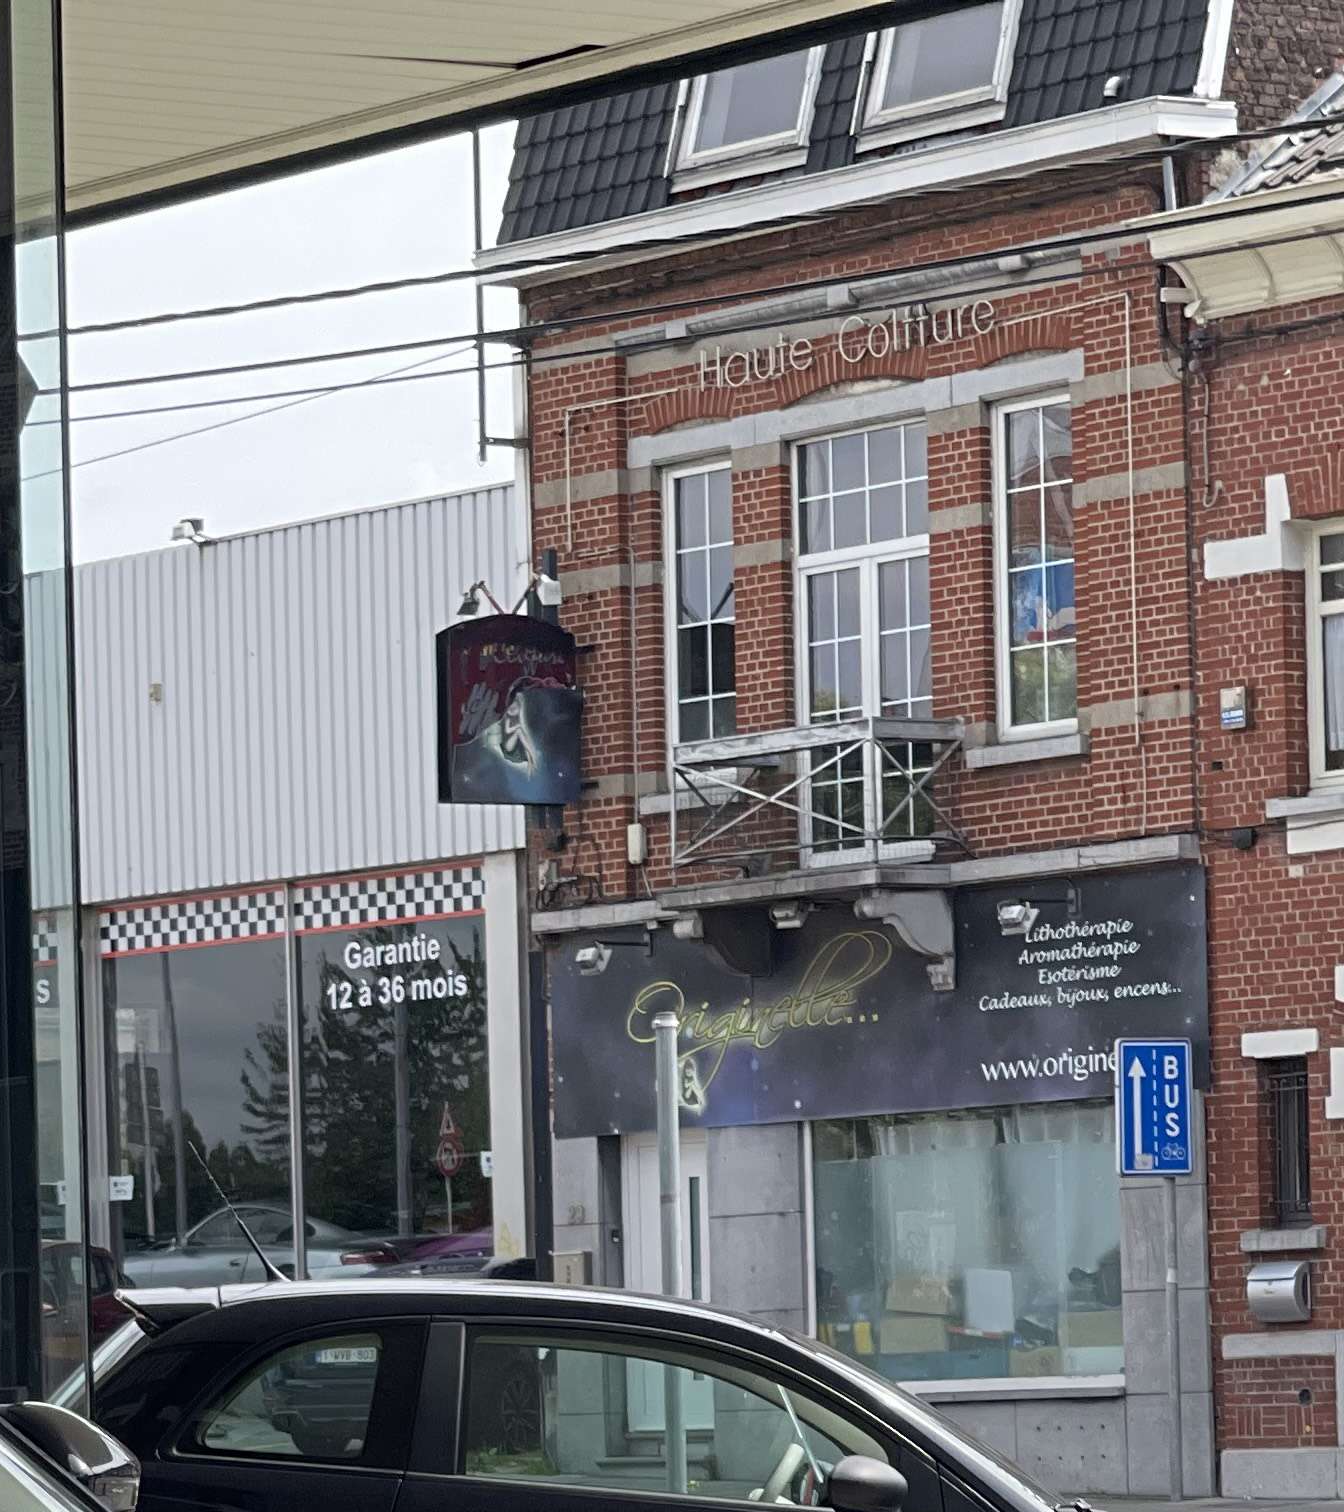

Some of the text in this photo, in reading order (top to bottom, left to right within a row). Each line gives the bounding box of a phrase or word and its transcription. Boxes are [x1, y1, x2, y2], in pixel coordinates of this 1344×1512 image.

[699, 333, 814, 392] Haute
[344, 933, 441, 969] Garantie
[1018, 940, 1141, 965] Aromathérapie
[327, 970, 468, 1010] 12 à 36 mois
[1038, 964, 1123, 985] Esotérisme
[979, 992, 1052, 1012] Cadeaux,
[1057, 986, 1110, 1009] bijoux,
[1163, 1054, 1181, 1138] BUS
